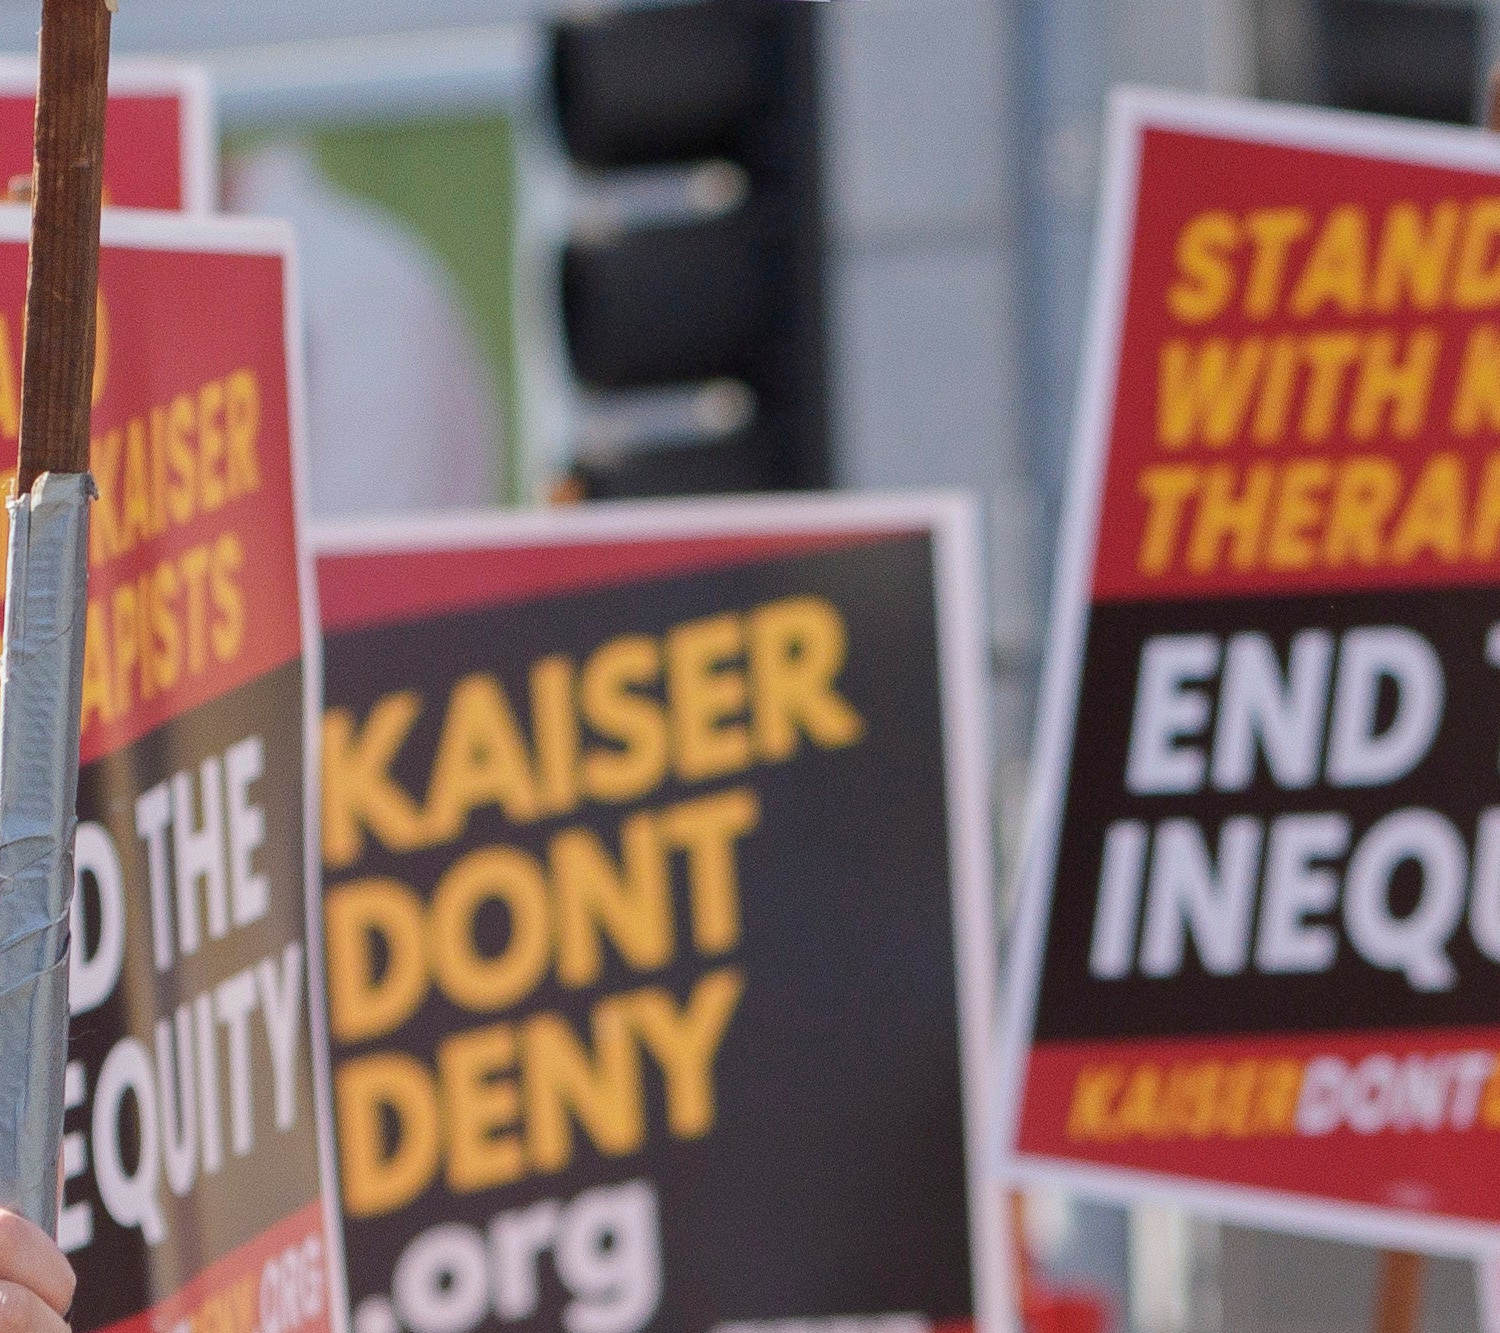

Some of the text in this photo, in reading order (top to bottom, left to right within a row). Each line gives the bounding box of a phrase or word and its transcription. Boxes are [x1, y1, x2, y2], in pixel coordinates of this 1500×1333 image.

[1154, 329, 1441, 450] WITH
[320, 595, 866, 867] KAISER
[1124, 627, 1446, 797] END
[136, 733, 271, 975] THE
[324, 786, 761, 1045] DONT
[336, 966, 746, 1220] DENY
